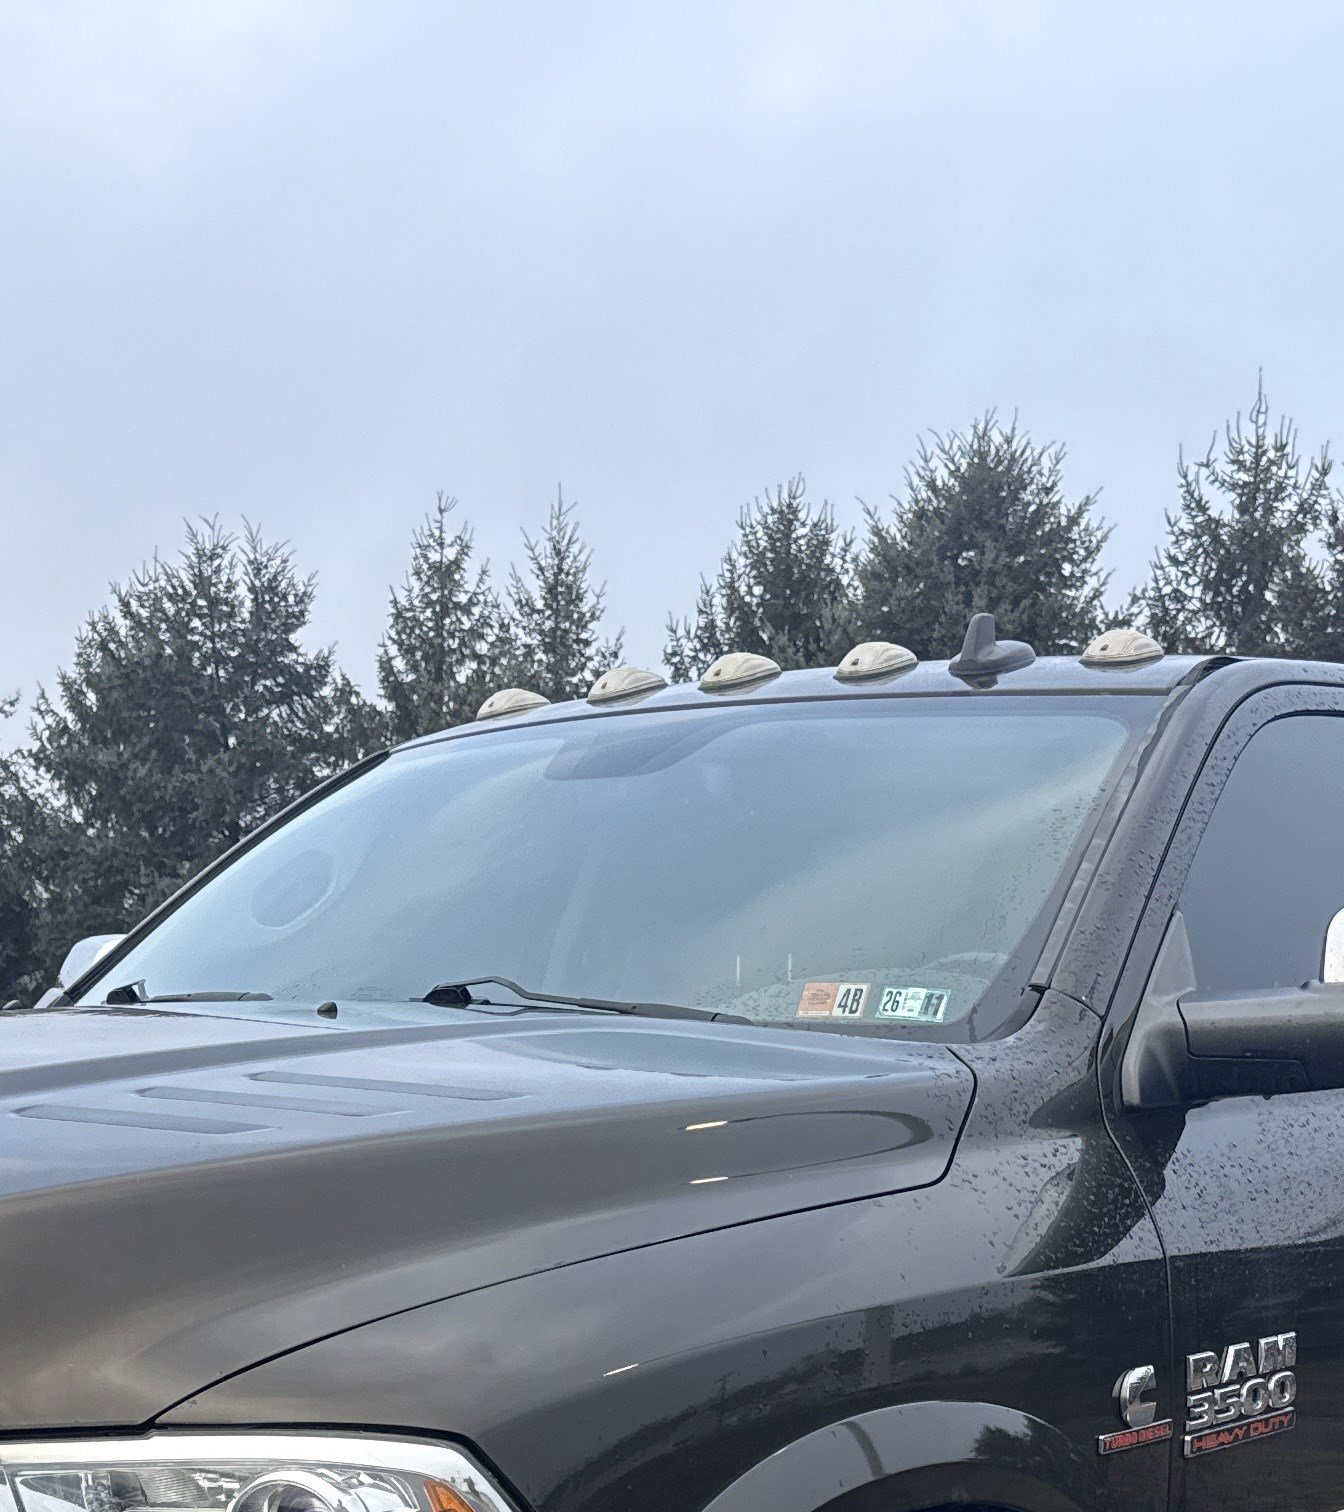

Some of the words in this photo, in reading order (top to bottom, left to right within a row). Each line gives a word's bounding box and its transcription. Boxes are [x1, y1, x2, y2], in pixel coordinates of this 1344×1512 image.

[837, 988, 863, 1015] 4B
[882, 990, 902, 1012] 26
[924, 993, 945, 1017] 11
[1186, 1331, 1297, 1390] RAM
[1186, 1370, 1296, 1431] 3500
[1192, 1426, 1247, 1451] HEAVY
[1249, 1412, 1293, 1437] DUTY
